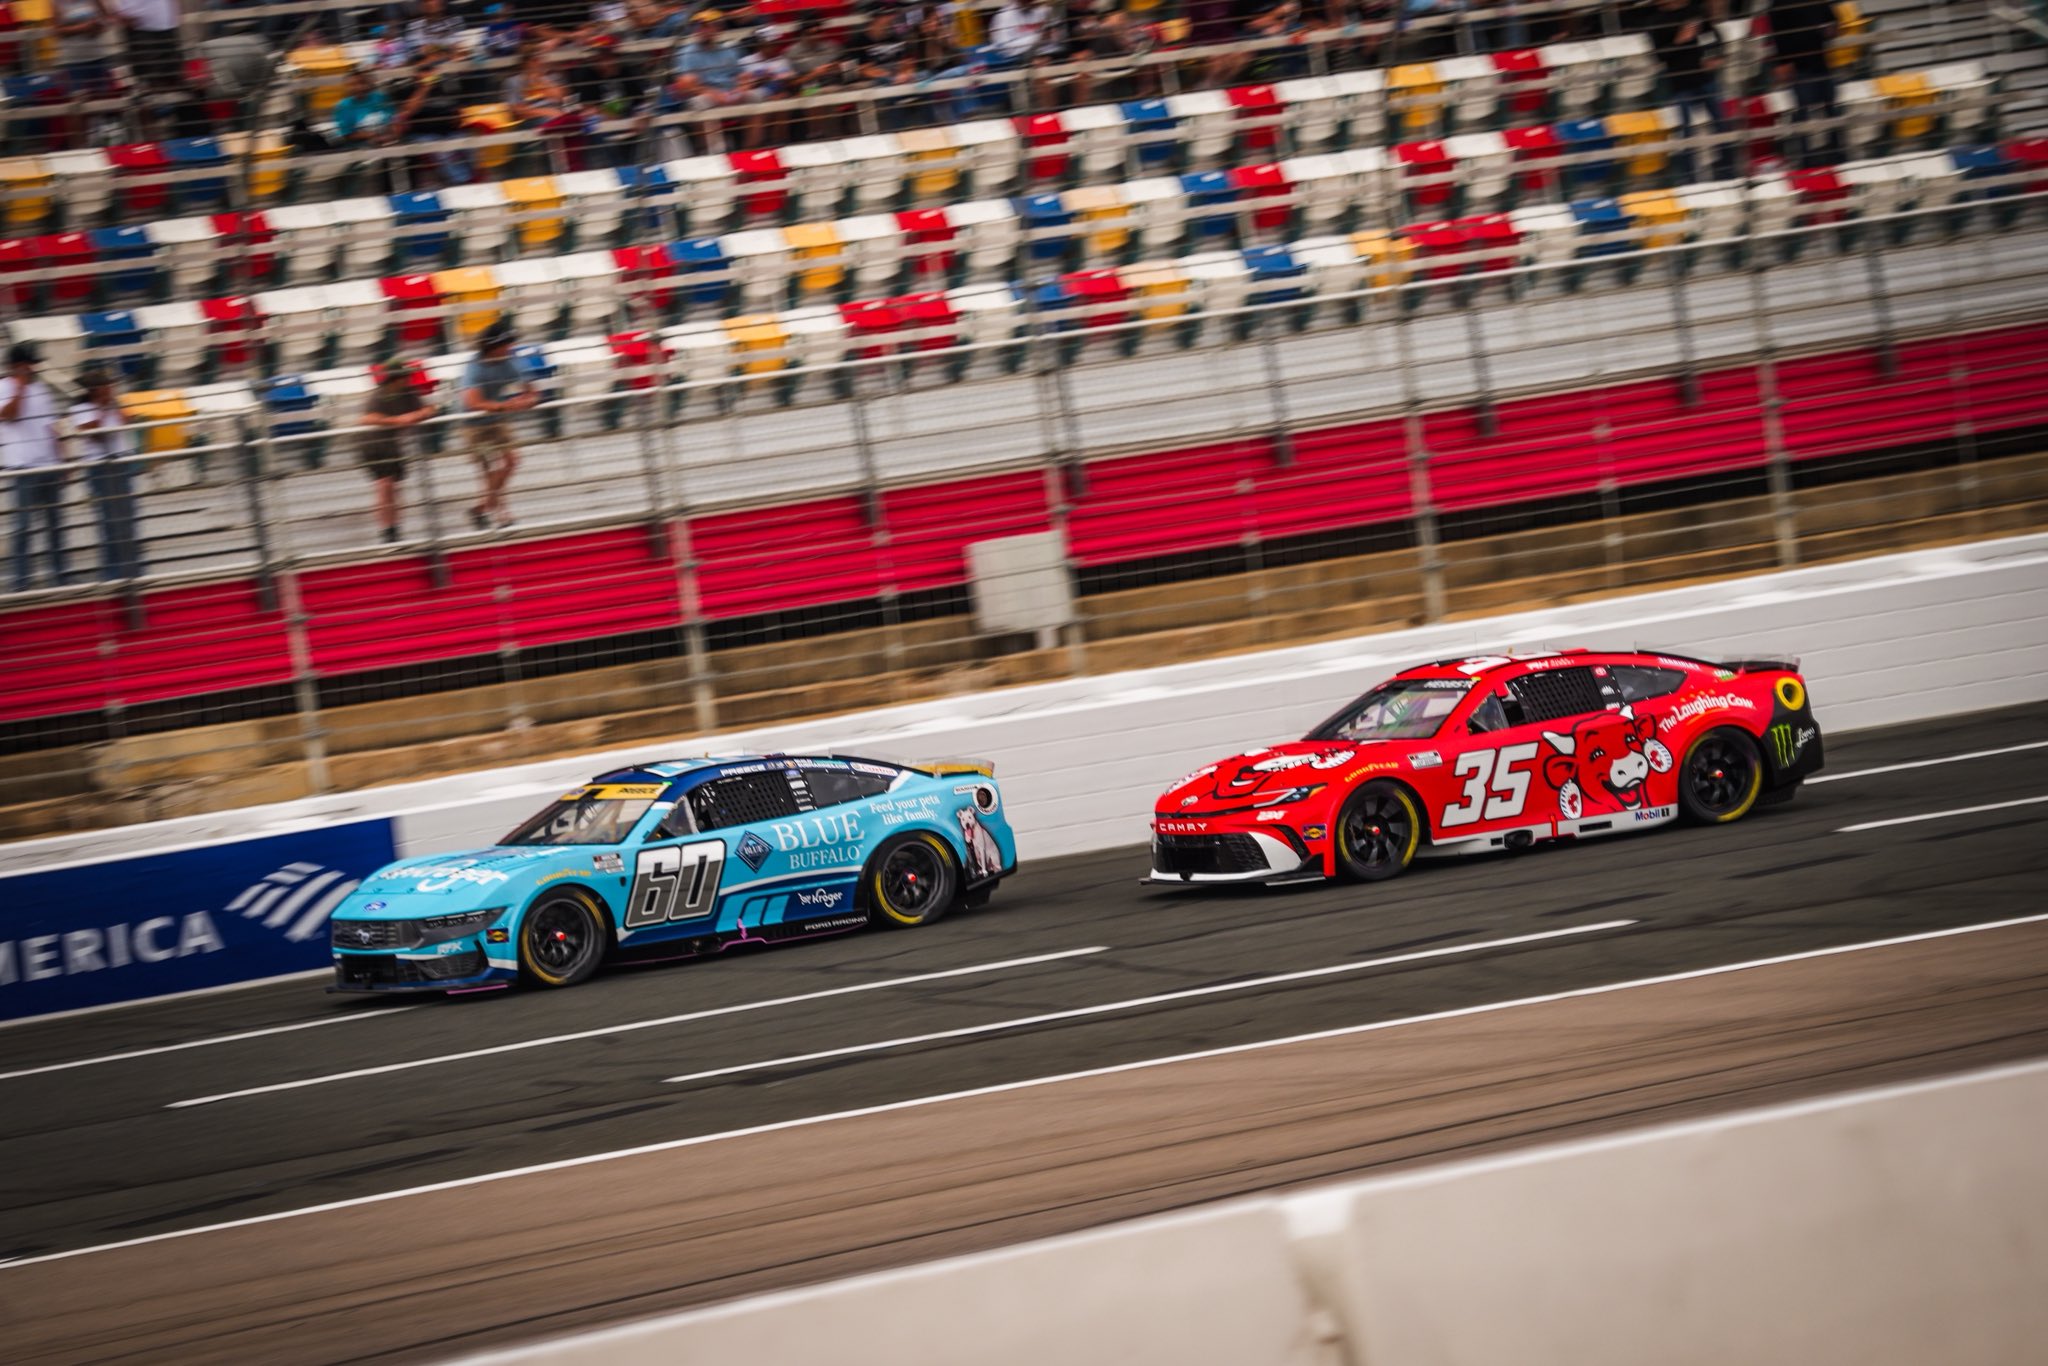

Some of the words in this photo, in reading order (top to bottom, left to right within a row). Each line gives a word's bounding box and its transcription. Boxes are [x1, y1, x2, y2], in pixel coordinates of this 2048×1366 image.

[1659, 714, 1678, 733] The
[1670, 694, 1729, 721] Laughing
[1726, 692, 1754, 709] Cow
[1440, 742, 1539, 828] 35
[870, 800, 895, 814] Feed
[895, 799, 919, 813] your
[918, 795, 941, 808] pets
[1635, 808, 1660, 821] Mobil
[882, 813, 904, 825] like
[1159, 822, 1208, 832] CAMRY
[771, 810, 865, 852] BLUE
[789, 845, 861, 870] BUFFALO
[625, 839, 726, 929] 60
[811, 887, 843, 908] Kroger
